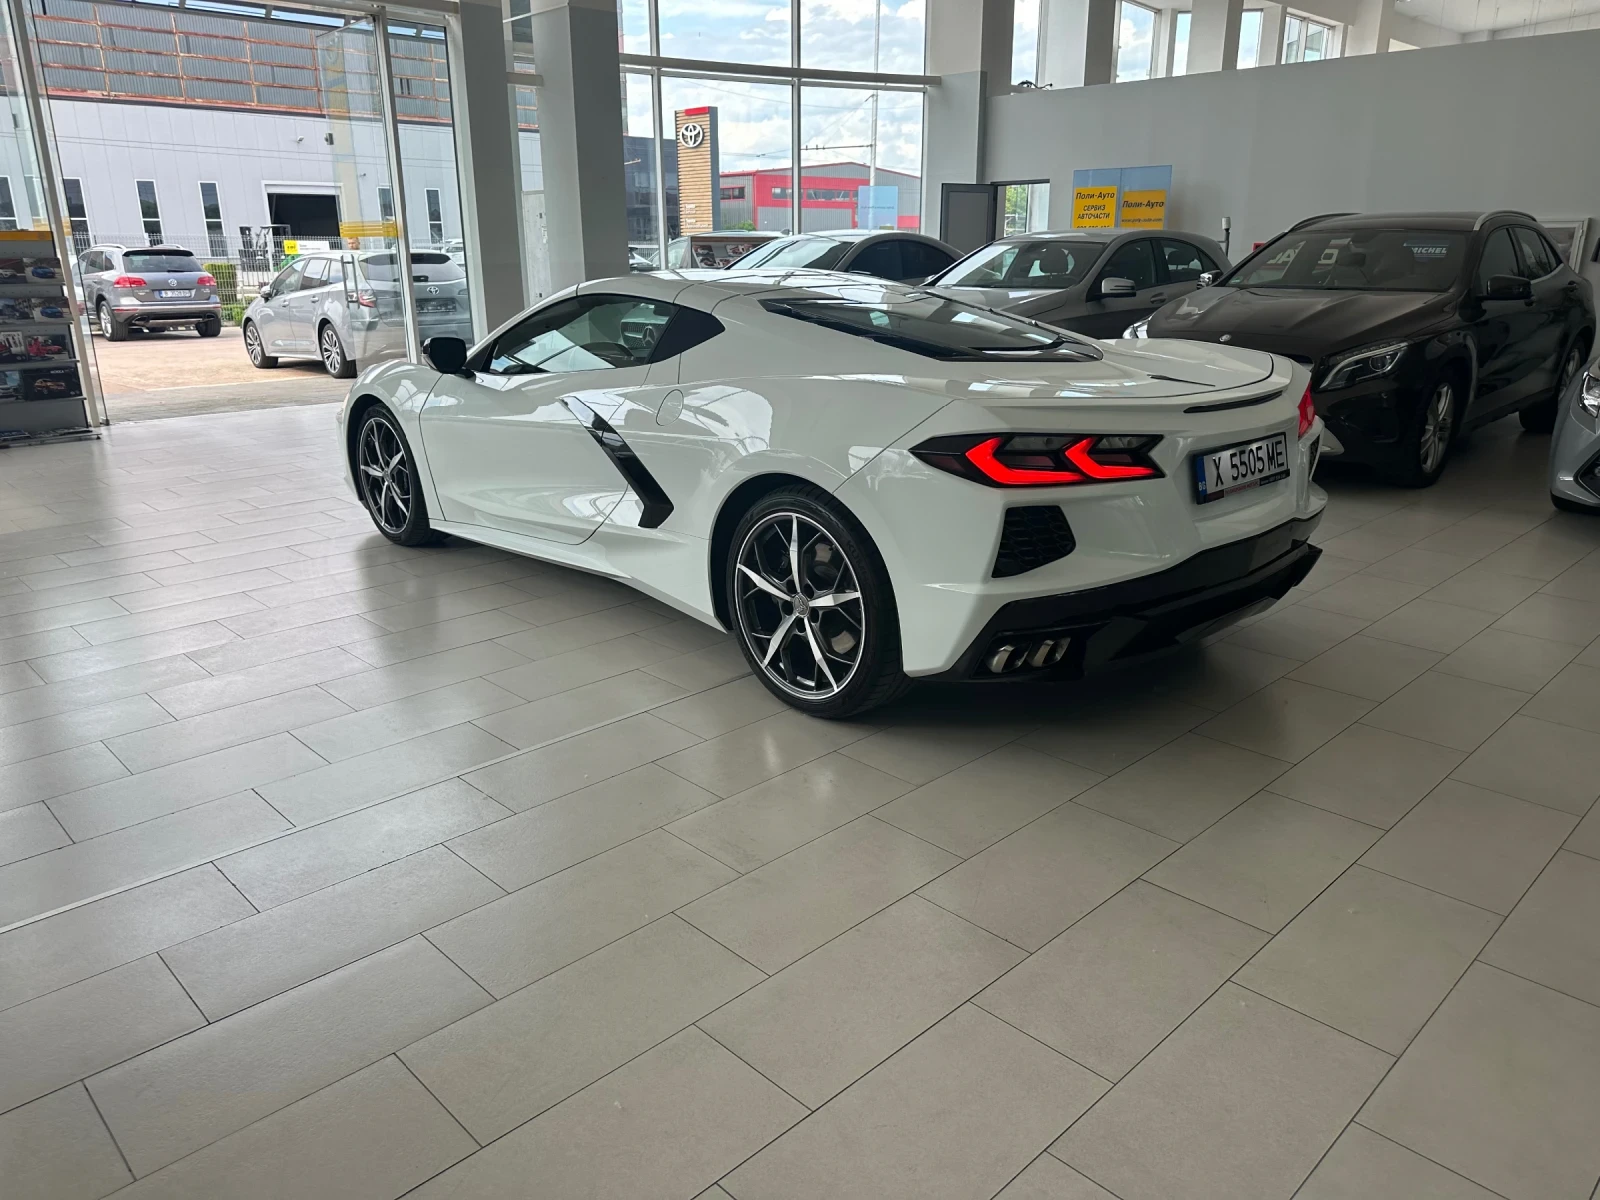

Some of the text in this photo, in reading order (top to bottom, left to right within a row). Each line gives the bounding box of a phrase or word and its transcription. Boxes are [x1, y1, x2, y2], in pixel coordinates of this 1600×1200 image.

[1076, 191, 1115, 200] Поли-Ауто
[1083, 204, 1105, 212] СЕРВИЗ
[1122, 200, 1164, 209] Поли-Ауто
[1077, 212, 1110, 220] АВТОЧАСТИ
[1230, 445, 1265, 481] 5505
[1266, 440, 1285, 471] ME
